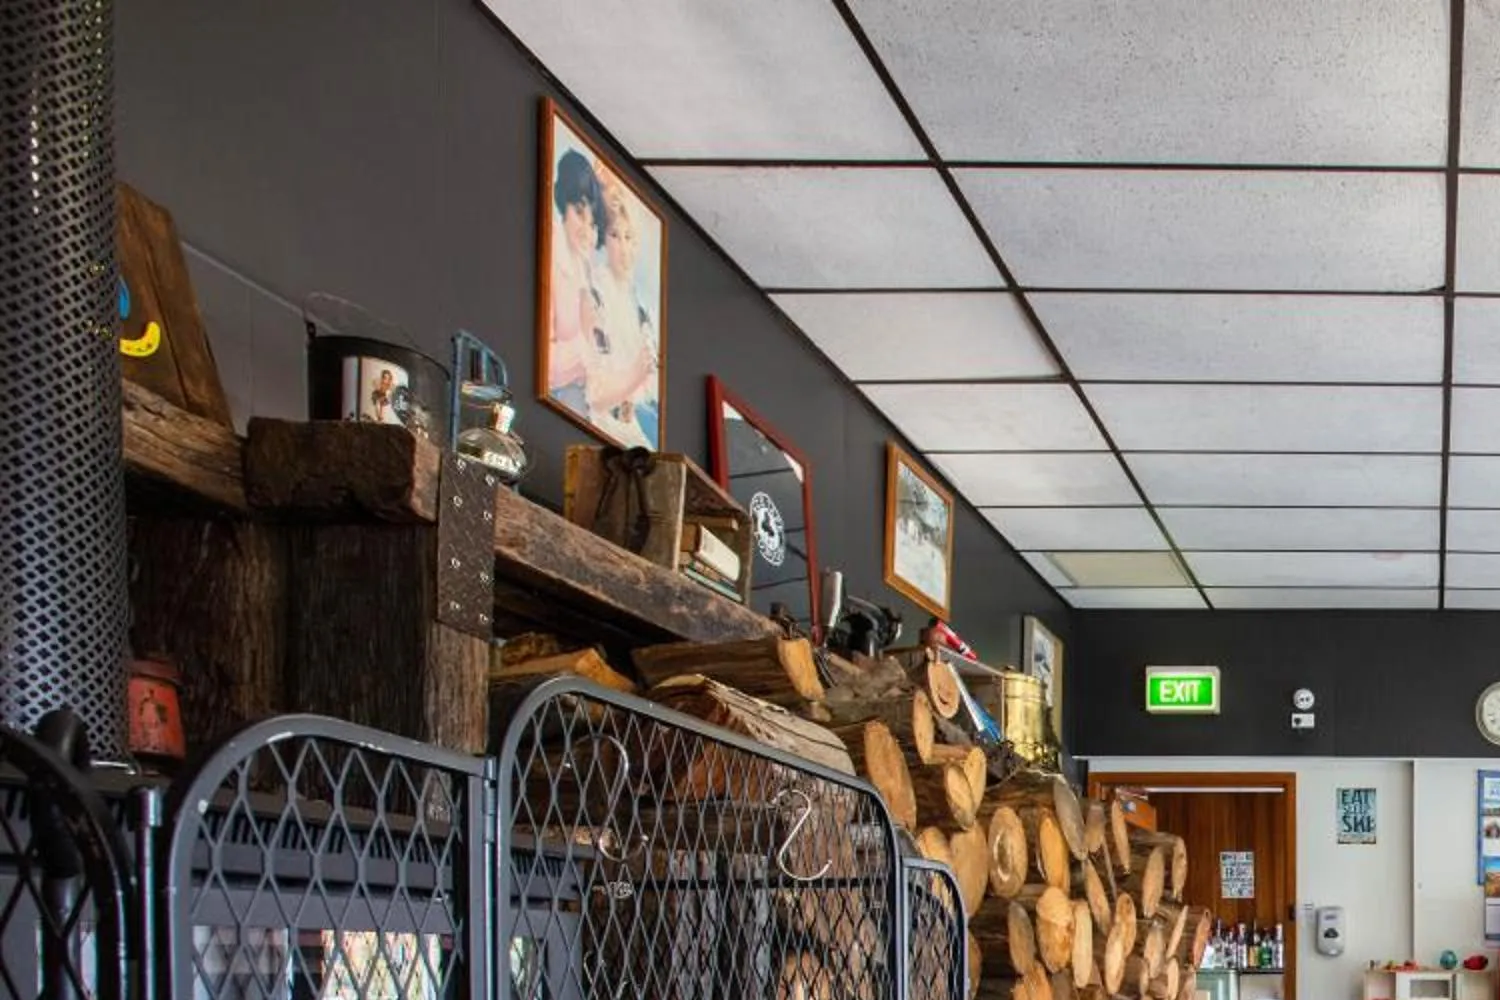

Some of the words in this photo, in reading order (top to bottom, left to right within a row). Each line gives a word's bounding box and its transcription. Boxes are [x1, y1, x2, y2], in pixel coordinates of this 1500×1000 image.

[1160, 680, 1201, 703] EXIT
[1341, 789, 1369, 804] EAT
[1342, 815, 1371, 832] SKI
